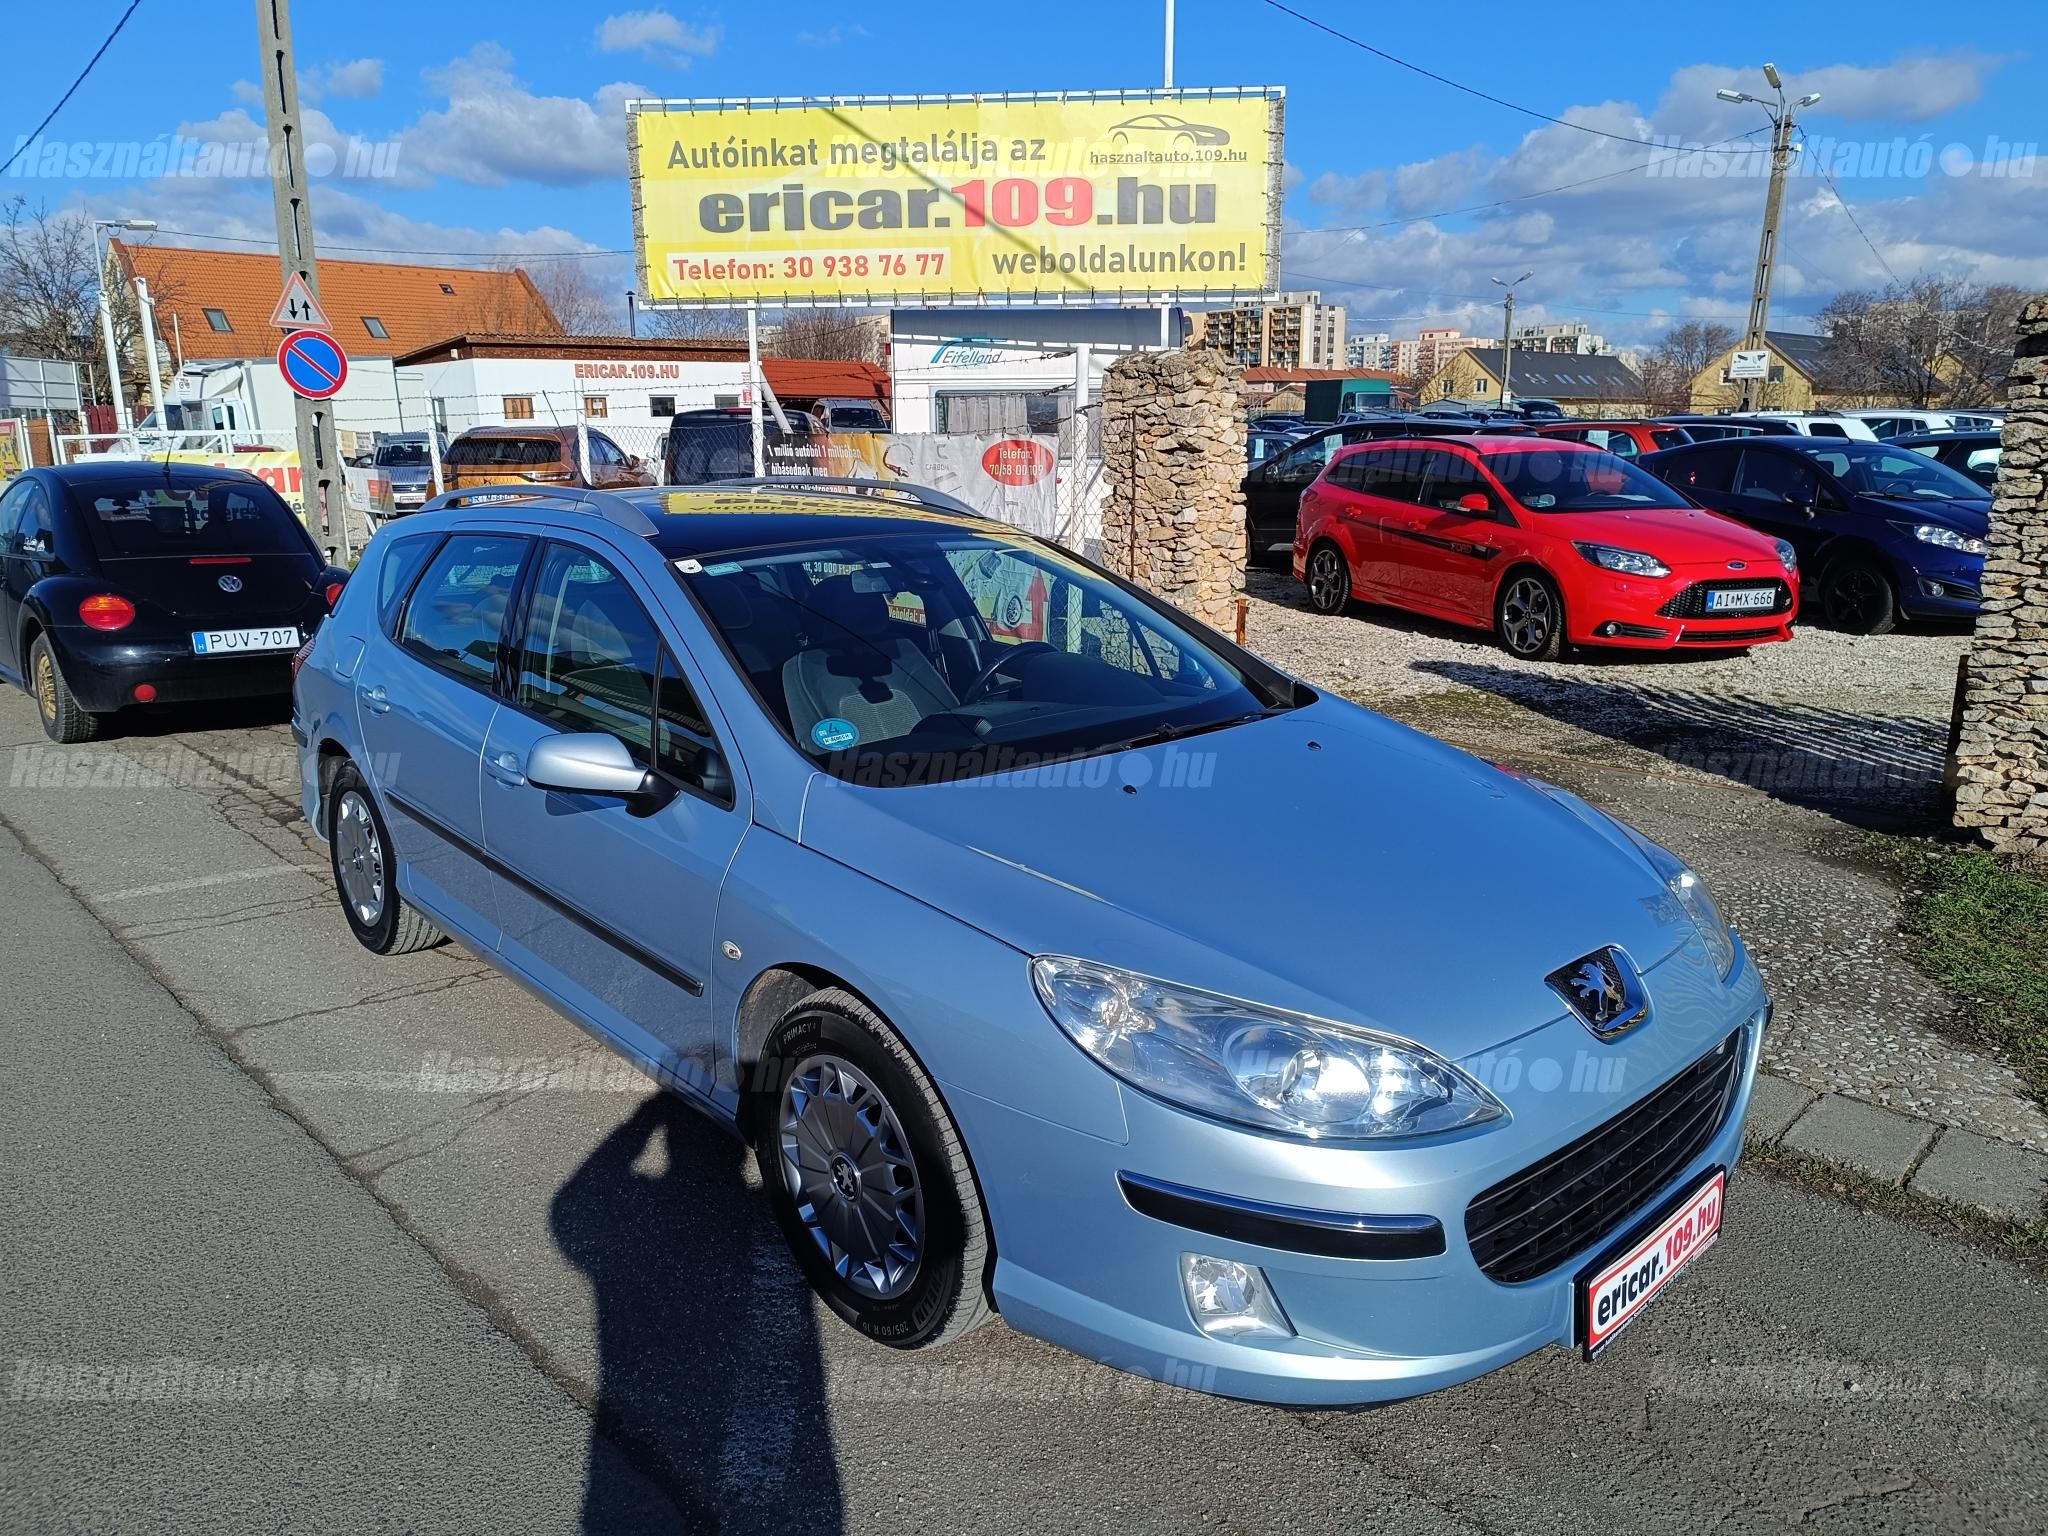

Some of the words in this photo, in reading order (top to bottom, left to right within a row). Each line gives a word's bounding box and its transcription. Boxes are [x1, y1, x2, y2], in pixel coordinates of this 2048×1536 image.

[667, 135, 818, 169] Autóinkat
[830, 129, 998, 171] megtalálja
[1010, 138, 1046, 161] az
[1090, 148, 1248, 163] hasznaltauto.109.hu
[698, 177, 1217, 233] ericar.109.hu
[672, 258, 774, 281] Telefon:
[783, 256, 813, 278] 30
[823, 255, 868, 277] 938
[878, 254, 906, 276] 76
[916, 253, 944, 276] 77
[992, 242, 1246, 275] weboldalunkon!
[942, 350, 1003, 364] Eifelland
[574, 363, 680, 379] ERICAR.109.HU
[209, 630, 293, 649] PUV-707
[782, 1022, 812, 1045] PRIMACY
[1597, 1197, 1717, 1327] ericar.109.hu
